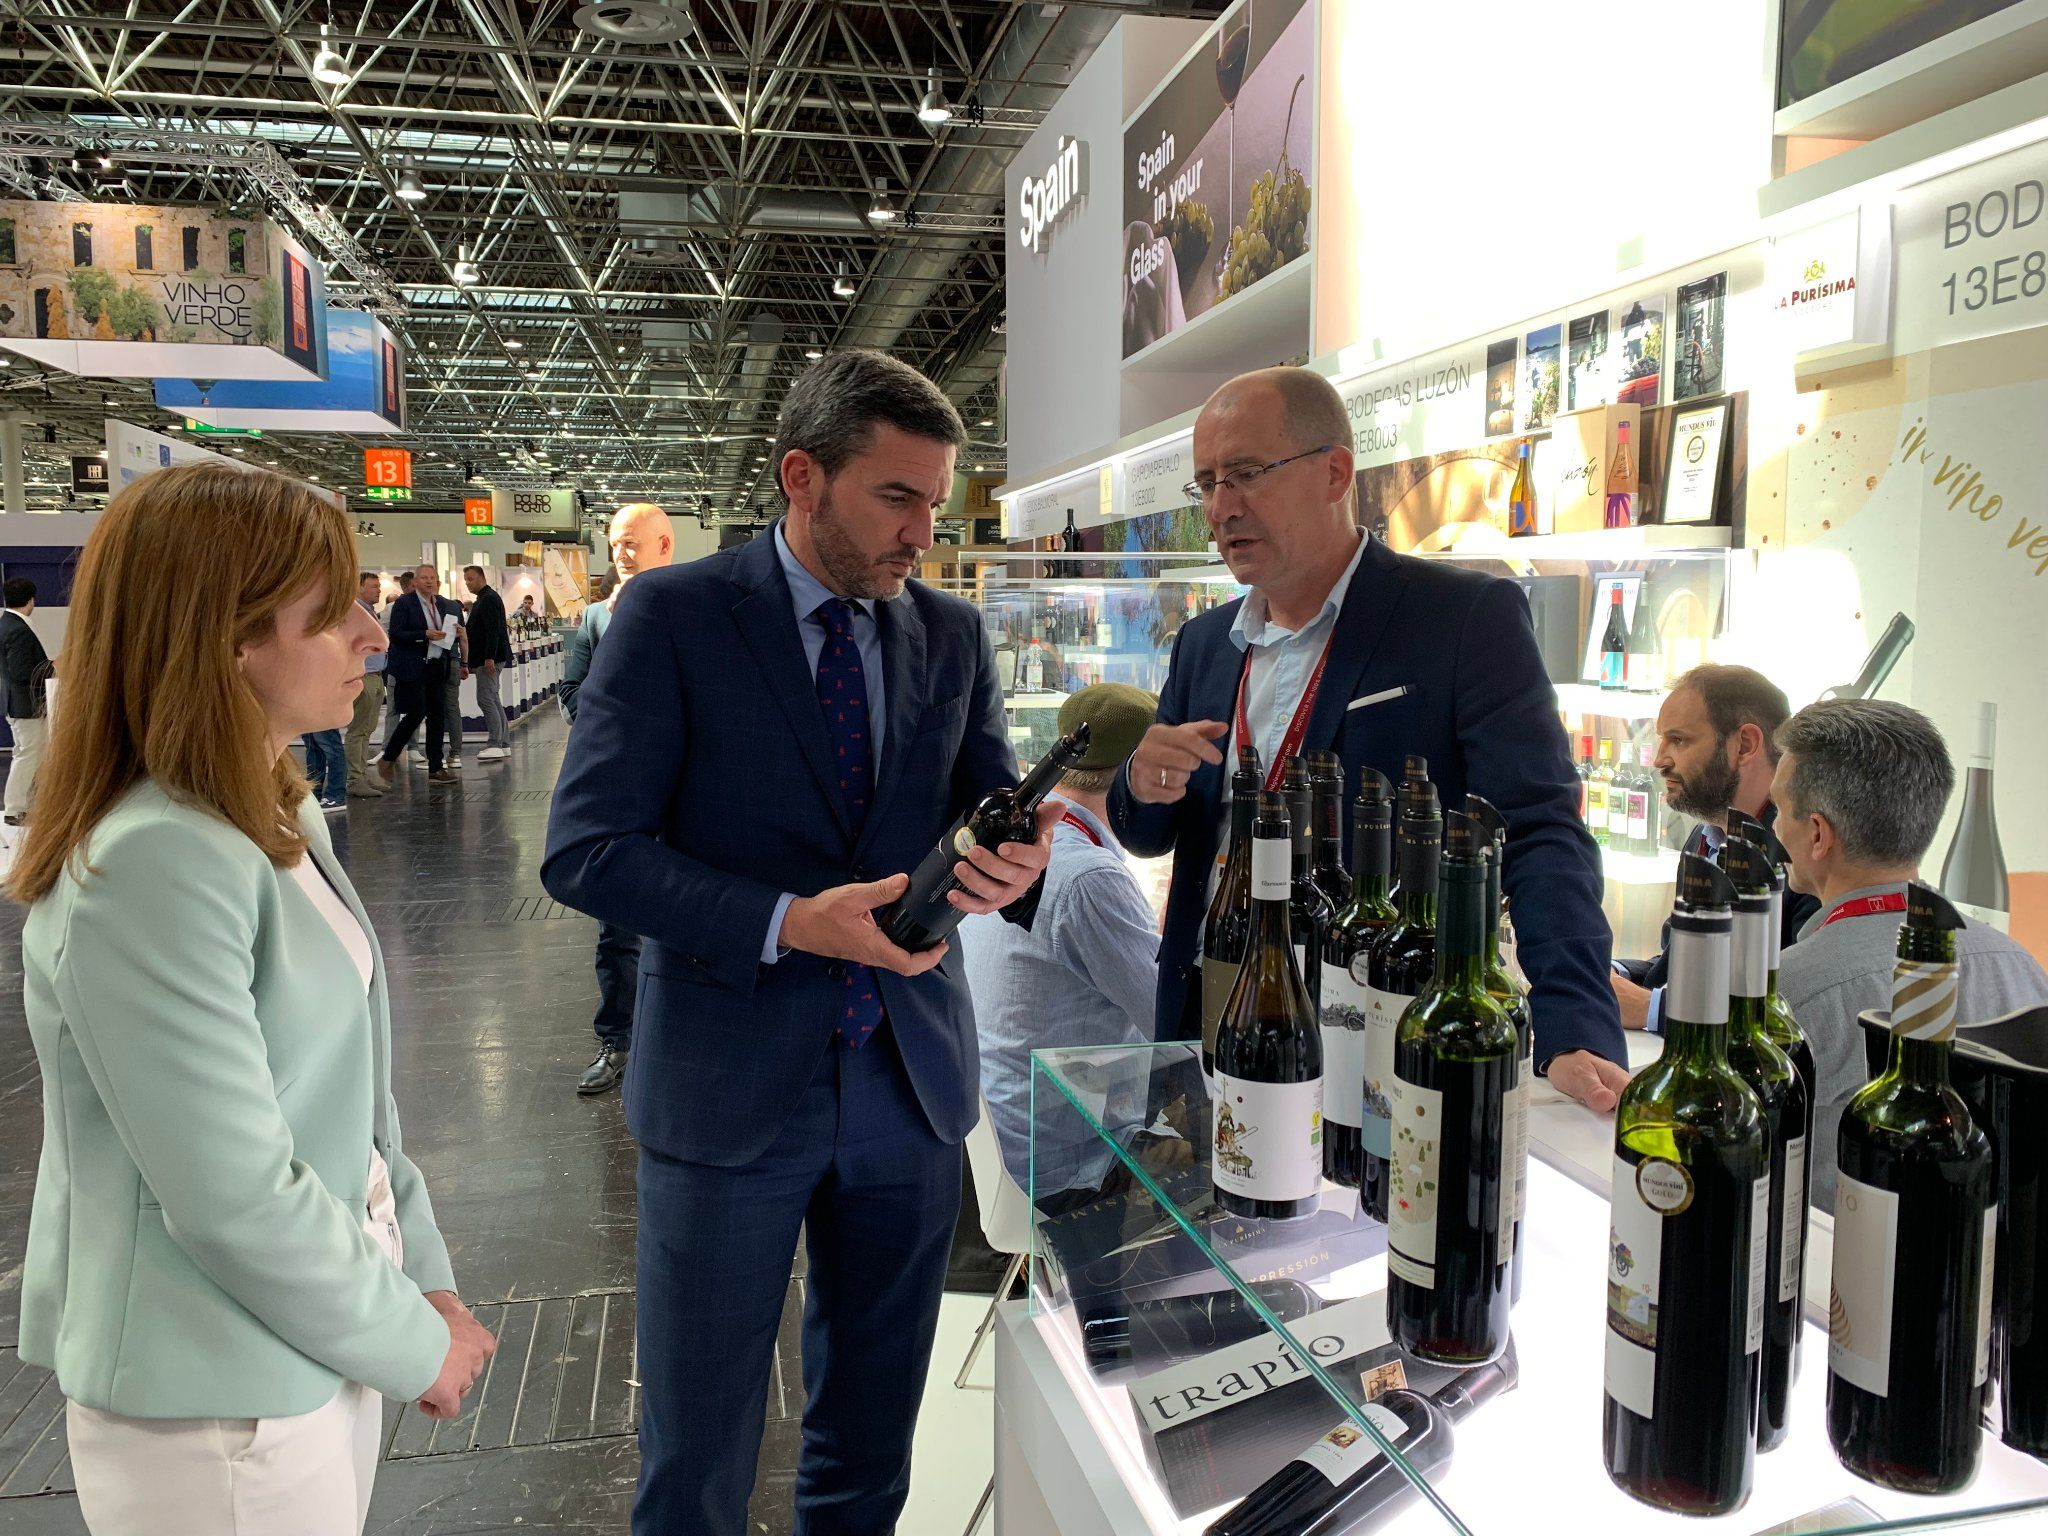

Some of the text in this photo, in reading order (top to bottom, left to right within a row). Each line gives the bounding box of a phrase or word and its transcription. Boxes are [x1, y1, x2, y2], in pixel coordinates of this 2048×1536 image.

[1138, 130, 1175, 192] Spain
[1020, 135, 1079, 253] Spain
[1154, 158, 1204, 224] in your
[1944, 179, 2048, 249] BOD
[1130, 238, 1165, 285] Glass
[163, 282, 246, 304] VINHO
[1791, 276, 1856, 305] PURÍSIMA
[1942, 250, 2048, 316] 13E8
[164, 304, 252, 337] VERDE
[1416, 360, 1471, 402] LUZÓN
[1353, 424, 1398, 455] 3E8003
[373, 460, 398, 483] 13
[1933, 455, 2003, 521] vino
[470, 507, 487, 523] 13
[1248, 1250, 1330, 1284] XPRESSION
